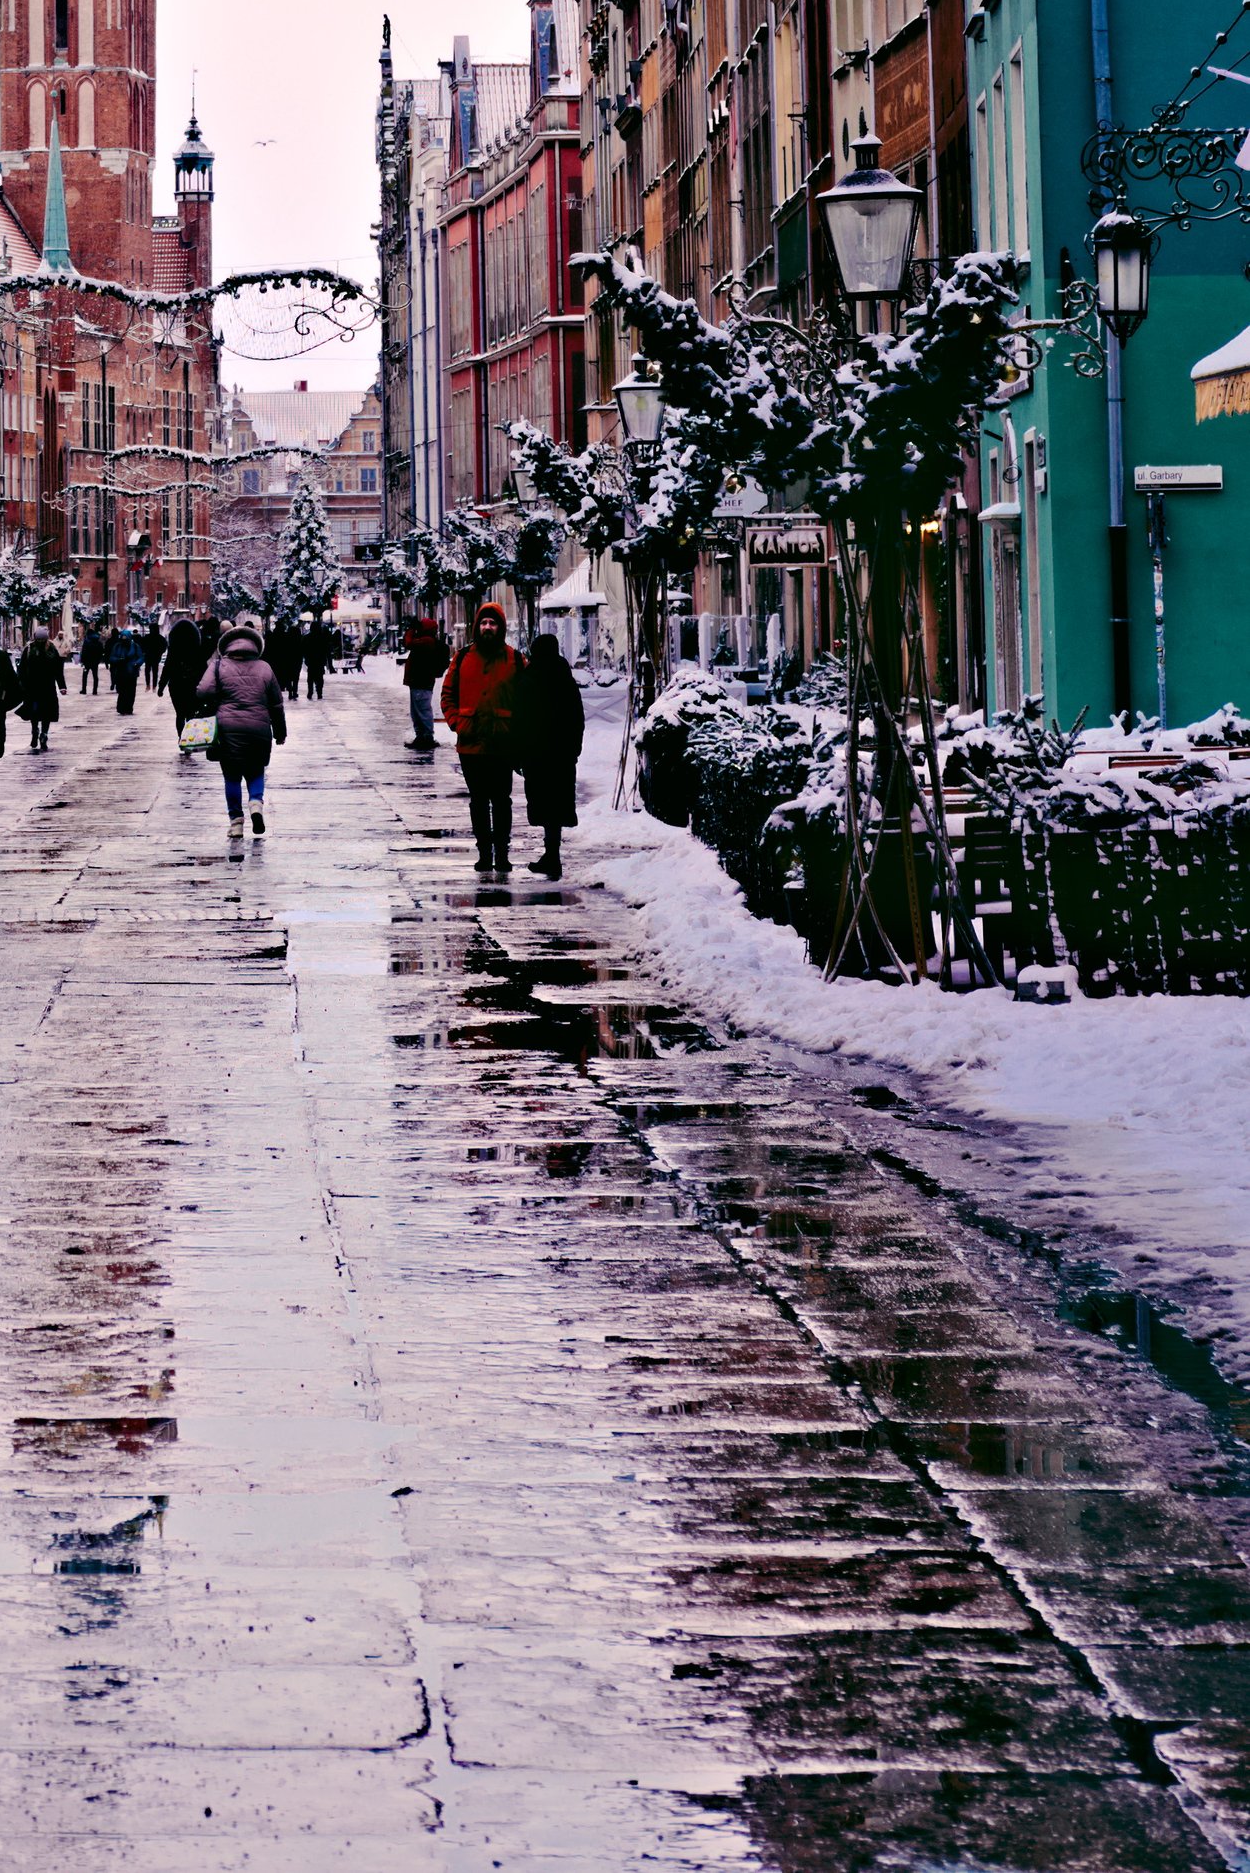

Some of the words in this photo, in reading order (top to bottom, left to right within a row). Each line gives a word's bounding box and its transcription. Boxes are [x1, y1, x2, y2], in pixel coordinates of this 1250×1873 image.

[1137, 471, 1148, 480] ul.
[1150, 470, 1183, 482] Garbary
[753, 532, 821, 555] KANTOR
